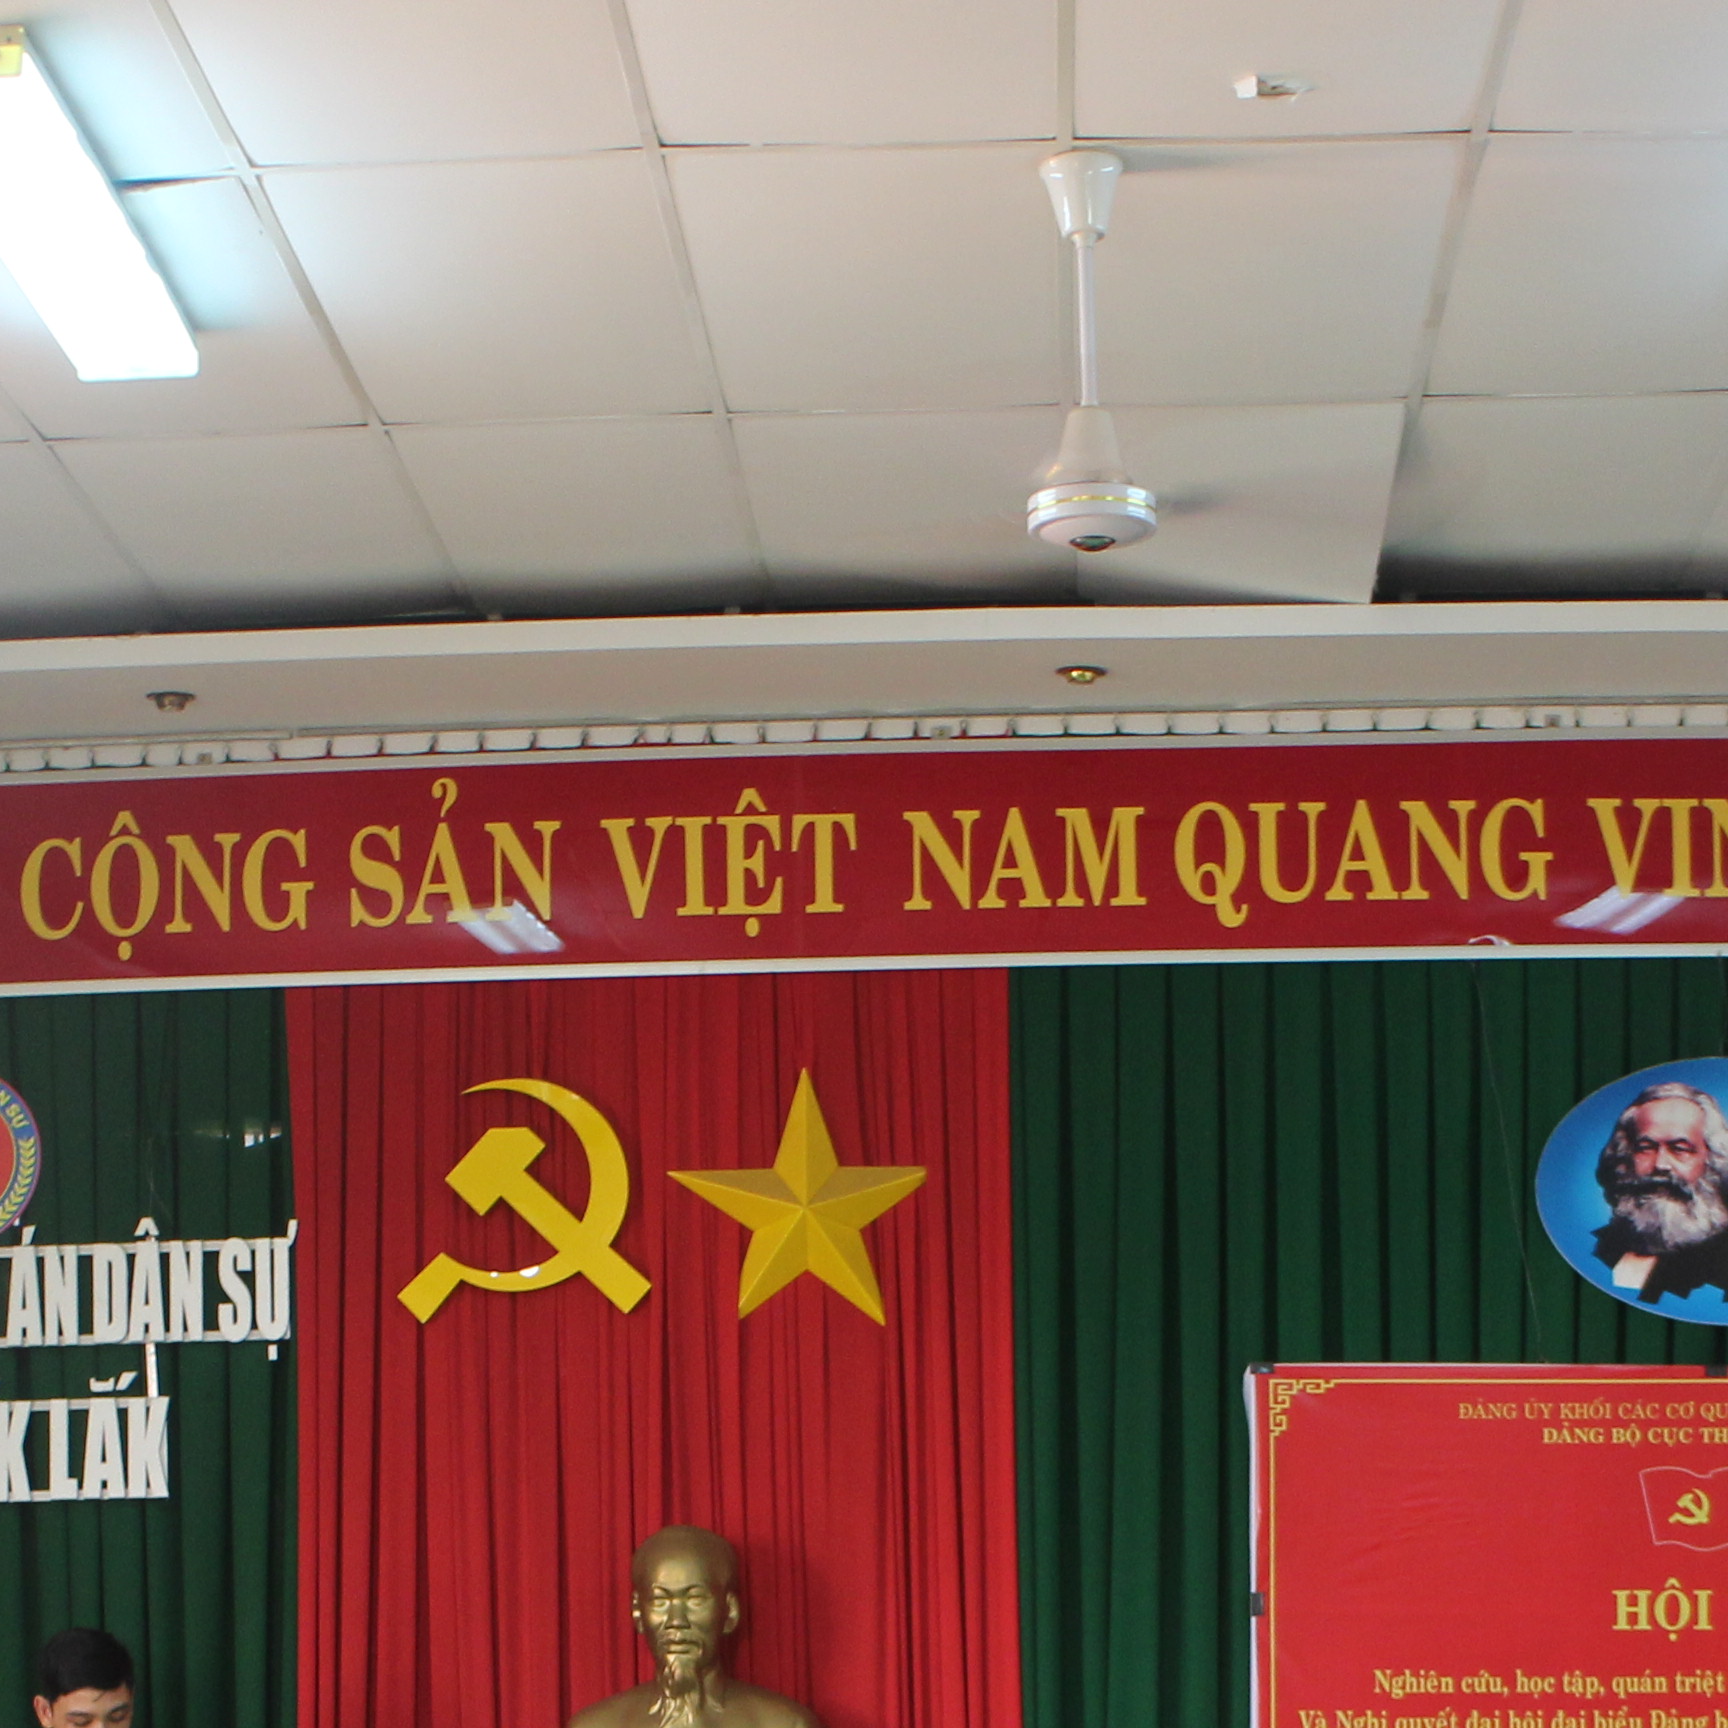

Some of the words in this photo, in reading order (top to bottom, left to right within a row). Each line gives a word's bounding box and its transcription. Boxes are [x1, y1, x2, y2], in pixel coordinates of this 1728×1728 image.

[20, 810, 315, 961] CỘNG
[349, 777, 562, 928] SẢN
[600, 787, 857, 937] VIỆT
[902, 806, 1147, 911] NAM
[1174, 797, 1554, 928] QUANG
[6, 1224, 79, 1347] ÁN
[91, 1216, 204, 1344] DÂN
[217, 1218, 298, 1361] SỰ
[50, 1371, 170, 1500] LẮK
[1459, 1399, 1519, 1421] ĐẢNG
[1560, 1398, 1613, 1421] KHỐI
[1618, 1399, 1661, 1421] CÁC
[1666, 1401, 1696, 1421] CƠ
[1543, 1422, 1606, 1445] ĐẢNG
[1612, 1424, 1643, 1447] BỘ
[1648, 1428, 1694, 1448] CỤC
[1612, 1578, 1714, 1643] HỘI
[1374, 1670, 1456, 1701] Nghiên
[1461, 1670, 1511, 1698] cứu,
[1516, 1669, 1557, 1700] học
[1563, 1671, 1607, 1701] tập,
[1612, 1670, 1670, 1700] quán
[1675, 1670, 1726, 1699] triệt
